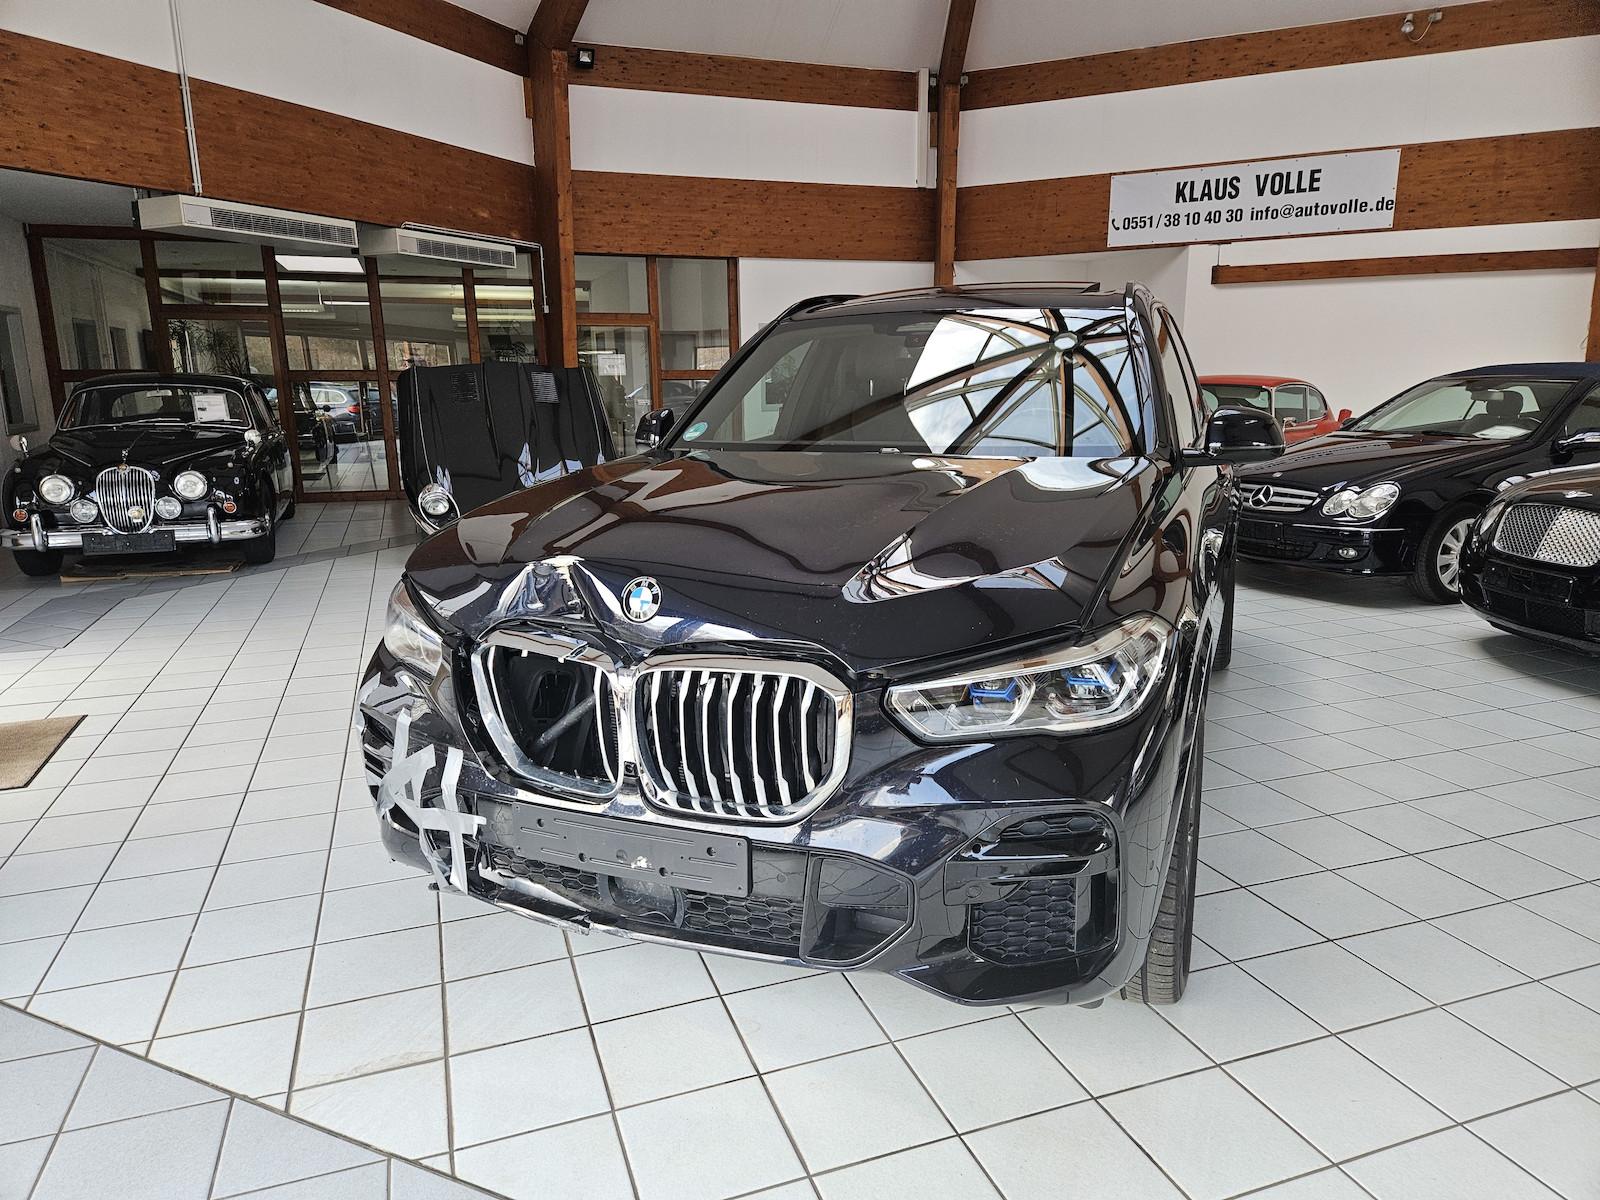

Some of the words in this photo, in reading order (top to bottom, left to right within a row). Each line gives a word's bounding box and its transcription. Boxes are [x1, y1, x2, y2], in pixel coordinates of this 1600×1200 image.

[1175, 176, 1240, 203] KLAUS
[1255, 168, 1322, 197] VOLLE
[1184, 212, 1200, 226] 10
[1204, 210, 1221, 224] 40
[1225, 208, 1243, 223] 30
[1250, 196, 1394, 220] info@autovolle.de
